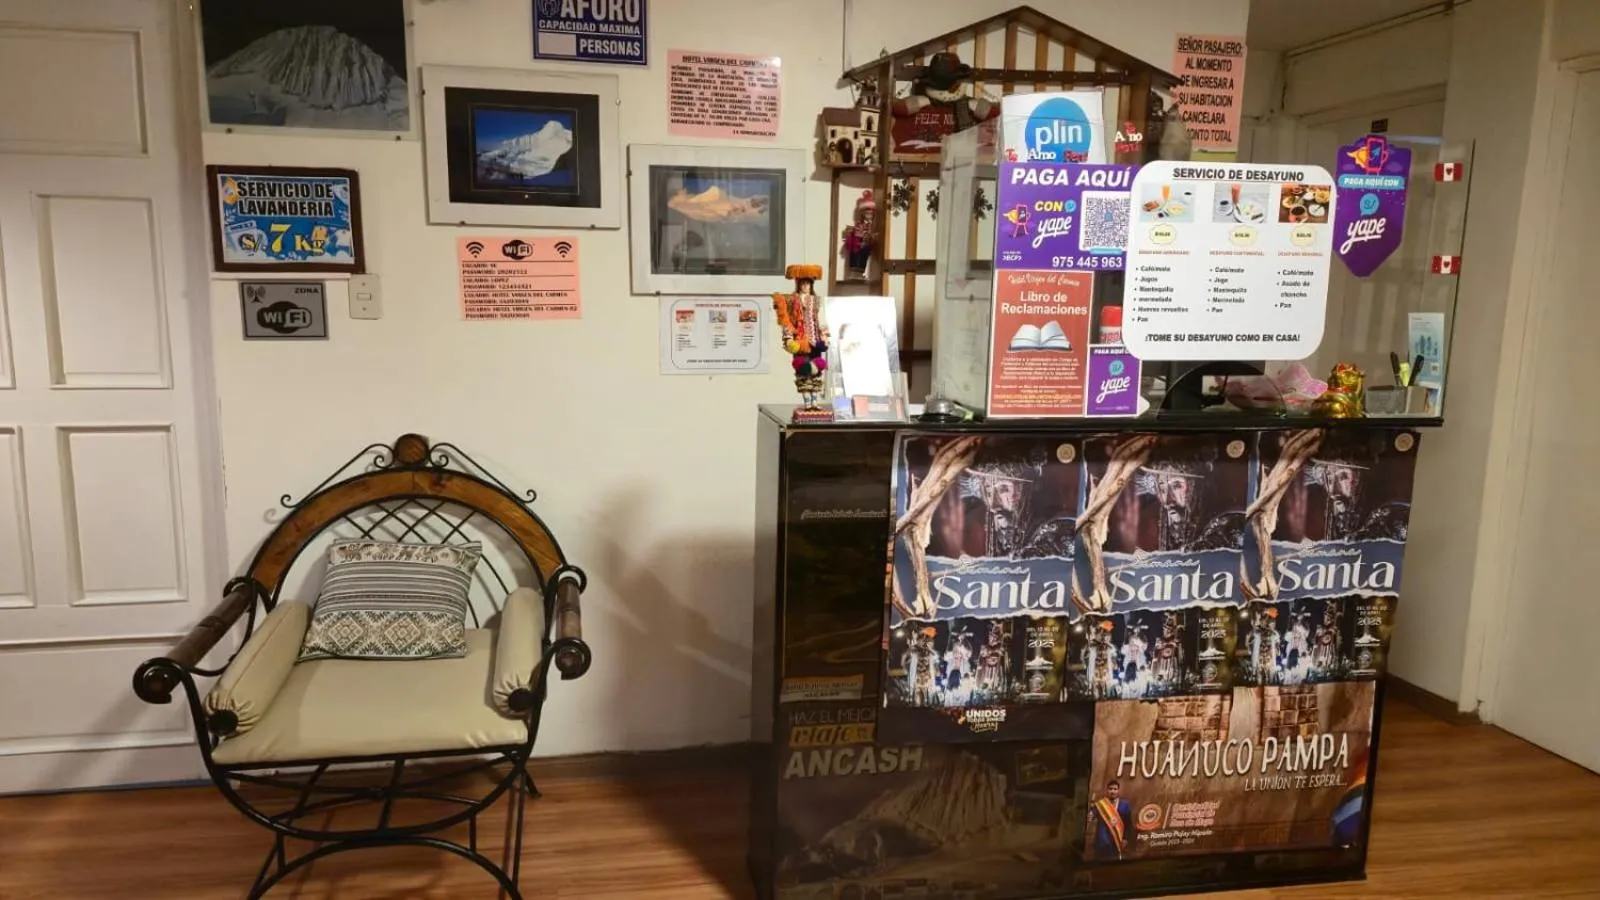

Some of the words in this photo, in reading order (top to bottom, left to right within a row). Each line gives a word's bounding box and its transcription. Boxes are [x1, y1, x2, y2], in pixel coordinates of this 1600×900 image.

[560, 0, 640, 24] AFORO
[538, 19, 595, 32] CAPACIDAD
[598, 23, 641, 35] MAXIMA
[579, 38, 640, 57] PERSONAS
[1178, 36, 1203, 51] SEÑOR
[1185, 57, 1194, 69] AL
[1195, 58, 1232, 72] MOMENTO
[1192, 76, 1228, 89] INGRESAR
[1228, 78, 1234, 90] A
[1178, 92, 1187, 105] SU
[1189, 94, 1233, 107] HABITACION
[1182, 111, 1225, 124] CANCELARA
[1034, 119, 1083, 150] plin
[1210, 129, 1233, 142] TOTAL
[1027, 148, 1057, 162] Amo
[1011, 169, 1069, 186] PAGA
[1074, 167, 1131, 187] AQUÍ
[1173, 168, 1225, 180] SERVICIO
[1228, 170, 1243, 180] DE
[1246, 171, 1305, 182] DESAYUNO
[1365, 177, 1384, 186] AQUÍ
[237, 181, 313, 199] SERVICIO
[315, 182, 335, 199] DE
[238, 199, 335, 217] LAVANDERIA
[1034, 201, 1064, 212] CON
[270, 223, 292, 253] 7
[1032, 216, 1072, 249] yape
[1340, 217, 1387, 255] yape
[1052, 256, 1074, 268] 975
[1076, 256, 1099, 268] 445
[1101, 256, 1123, 268] 963
[293, 287, 319, 295] ZONA
[1020, 291, 1051, 302] Libro
[1053, 291, 1067, 302] de
[1001, 303, 1088, 316] Reclamaciones
[1173, 334, 1186, 343] SU
[1187, 334, 1234, 343] DESAYUNO
[1235, 334, 1261, 343] COMO
[1262, 334, 1274, 343] EN
[1275, 334, 1301, 343] CASA!
[1096, 376, 1131, 404] yape
[1277, 554, 1395, 592] Santa
[933, 572, 1066, 611] Santa
[1110, 564, 1234, 604] Santa
[1357, 617, 1382, 626] 2025
[1200, 629, 1227, 639] 2025
[1027, 639, 1056, 648] 2025
[965, 709, 1007, 719] UNIDOS
[783, 745, 923, 780] ANCASH
[1117, 734, 1254, 779] HUÁNUCO
[1260, 732, 1350, 774] PAMPA
[1244, 778, 1256, 792] LA
[1295, 776, 1306, 789] TE
